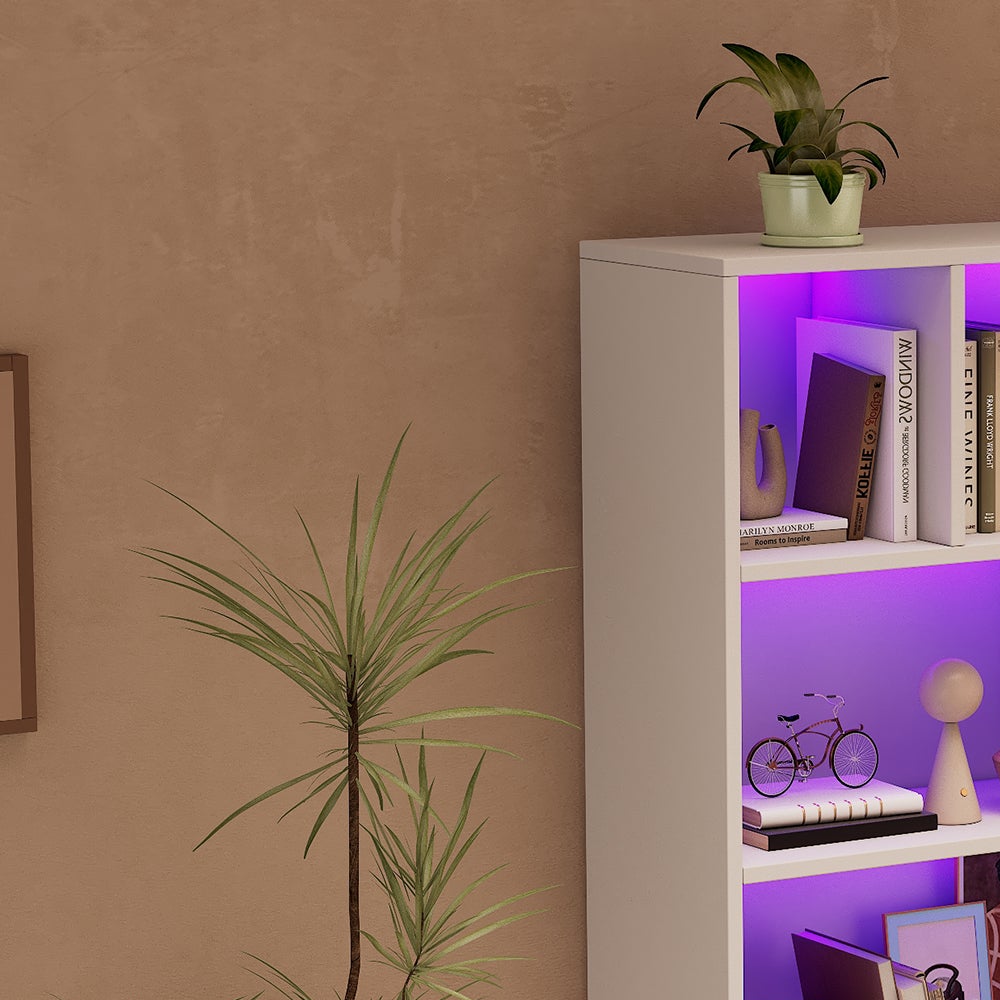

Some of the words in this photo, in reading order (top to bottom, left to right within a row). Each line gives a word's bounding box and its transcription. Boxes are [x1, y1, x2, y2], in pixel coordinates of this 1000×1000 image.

[986, 394, 994, 418] FRANK
[986, 418, 994, 441] LLOYD
[986, 441, 994, 470] WRIGHT
[855, 447, 874, 500] KOFFIE
[739, 525, 775, 537] ARILYN
[776, 522, 815, 534] MONROE
[754, 538, 777, 546] Rooms
[787, 535, 811, 544] Inspire
